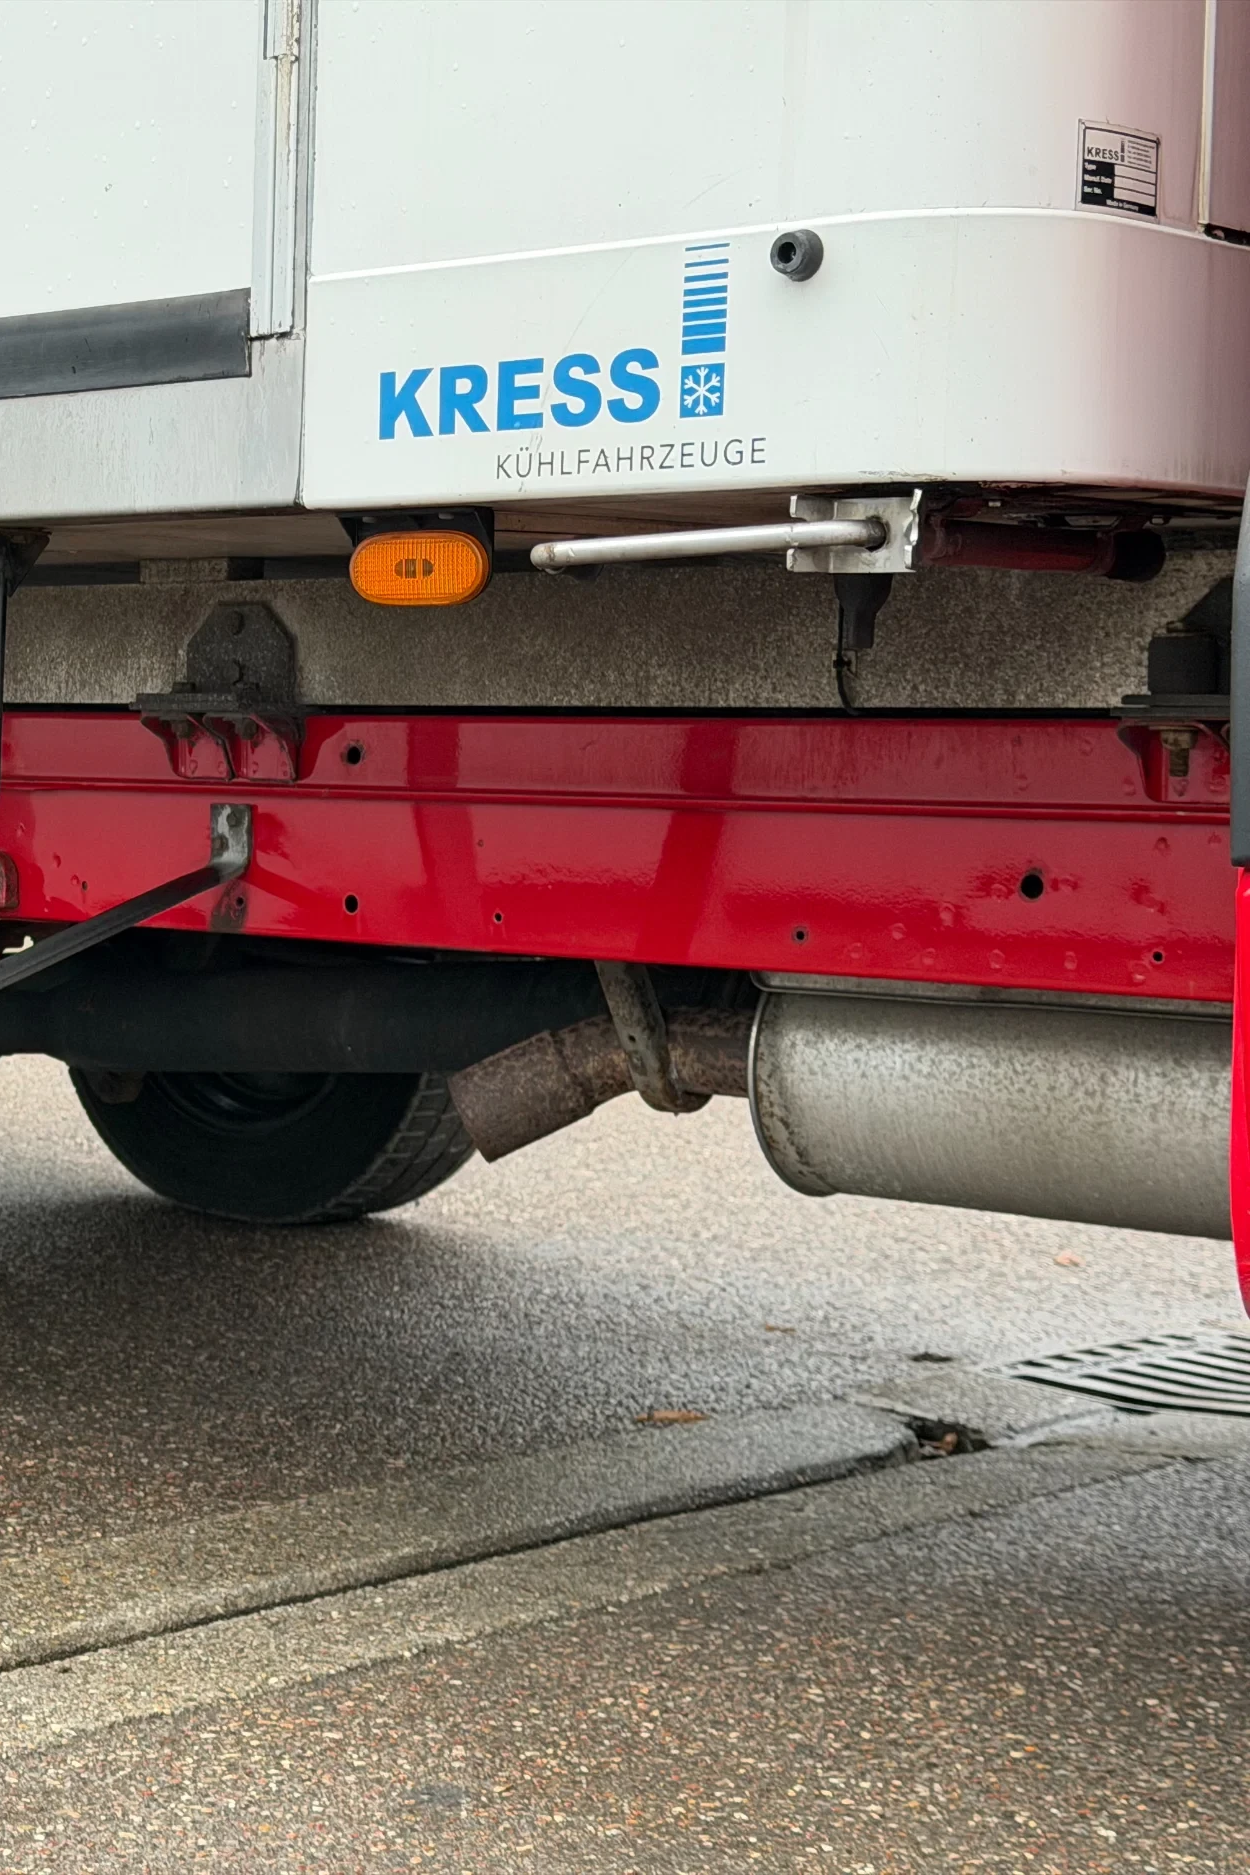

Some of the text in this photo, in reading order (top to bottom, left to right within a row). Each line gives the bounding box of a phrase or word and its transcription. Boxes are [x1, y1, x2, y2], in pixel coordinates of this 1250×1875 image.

[1086, 147, 1120, 161] KRESS
[378, 348, 661, 440] KRESS
[496, 437, 766, 479] KÜHLFAHRZEUGE
